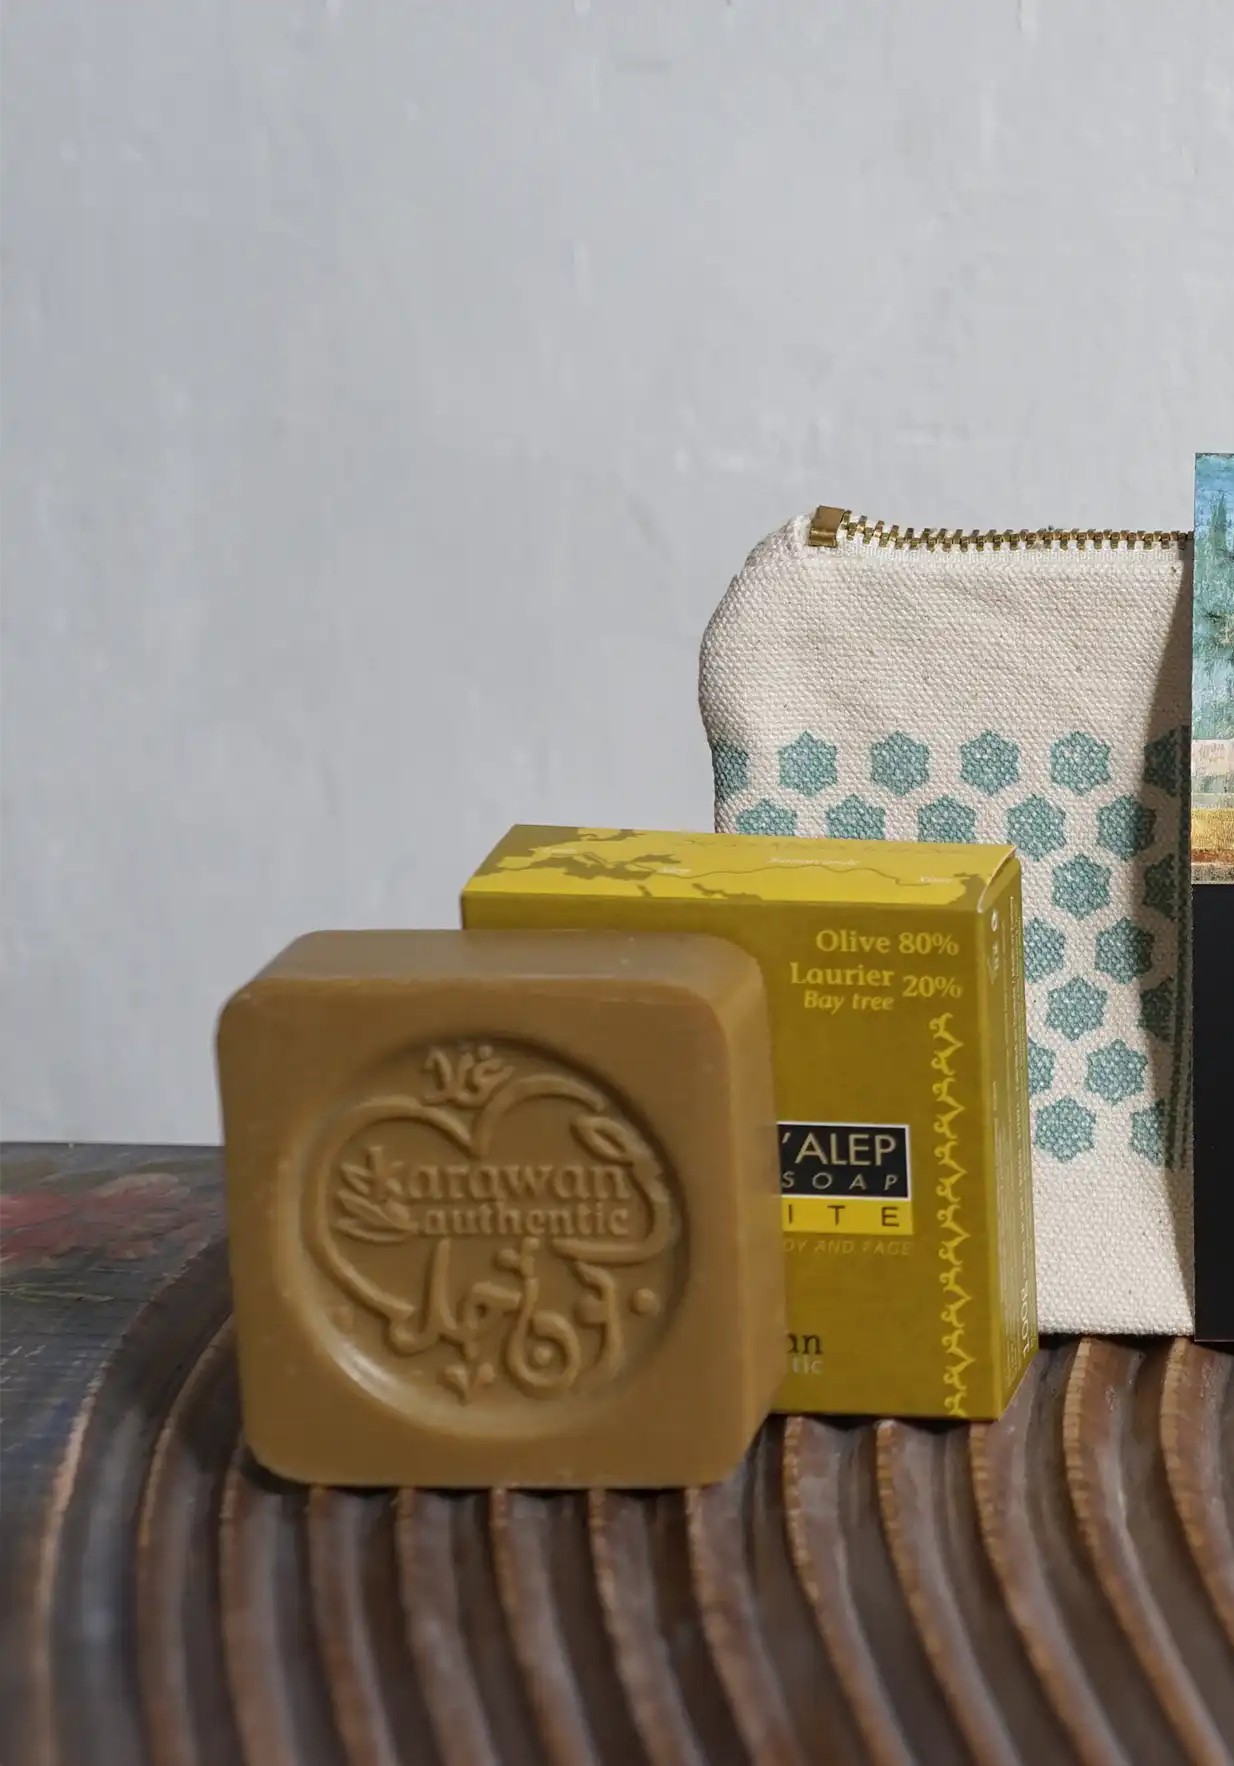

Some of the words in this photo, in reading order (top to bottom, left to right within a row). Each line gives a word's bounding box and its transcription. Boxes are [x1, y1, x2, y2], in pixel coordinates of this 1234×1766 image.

[816, 929, 891, 953] Olive
[898, 932, 960, 956] 80%
[789, 961, 895, 986] Laurier
[902, 975, 963, 998] 20%
[804, 990, 845, 1015] Bay
[852, 993, 894, 1010] tree
[782, 1131, 897, 1166] 'ALEP
[369, 1146, 632, 1199] karawan
[781, 1171, 899, 1190] SOAP
[423, 1203, 631, 1236] authentic
